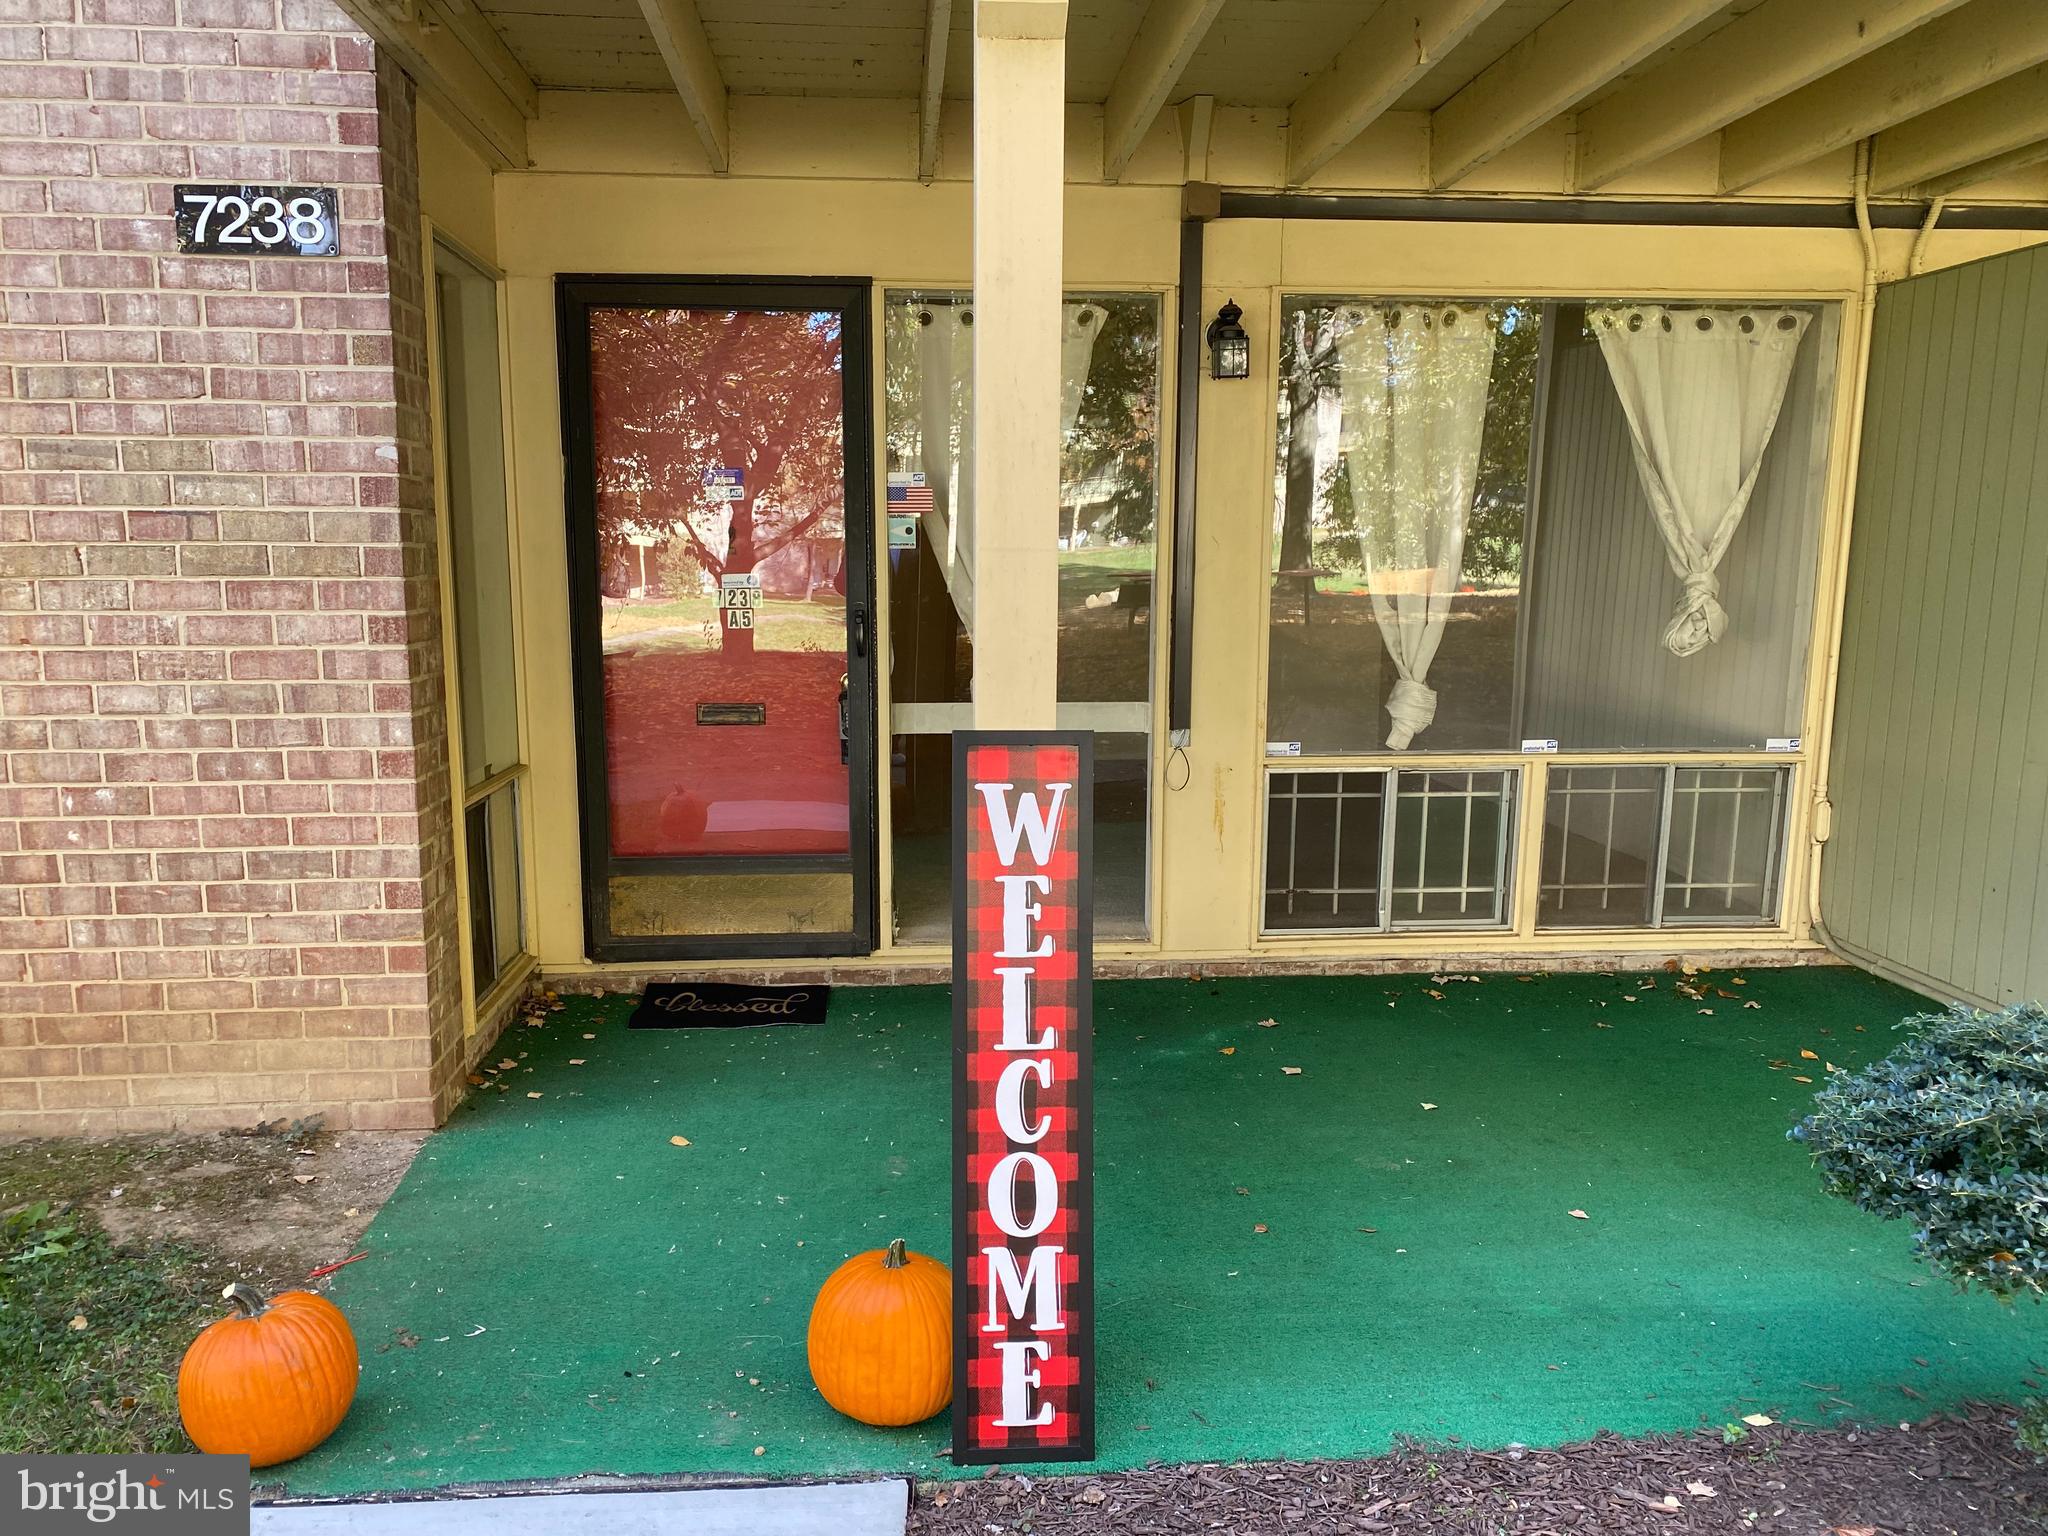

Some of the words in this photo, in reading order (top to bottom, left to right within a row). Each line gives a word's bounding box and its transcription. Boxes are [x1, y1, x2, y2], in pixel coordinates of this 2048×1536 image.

[183, 194, 325, 244] 7238
[729, 610, 751, 627] A5
[974, 783, 1071, 1428] WELCOME
